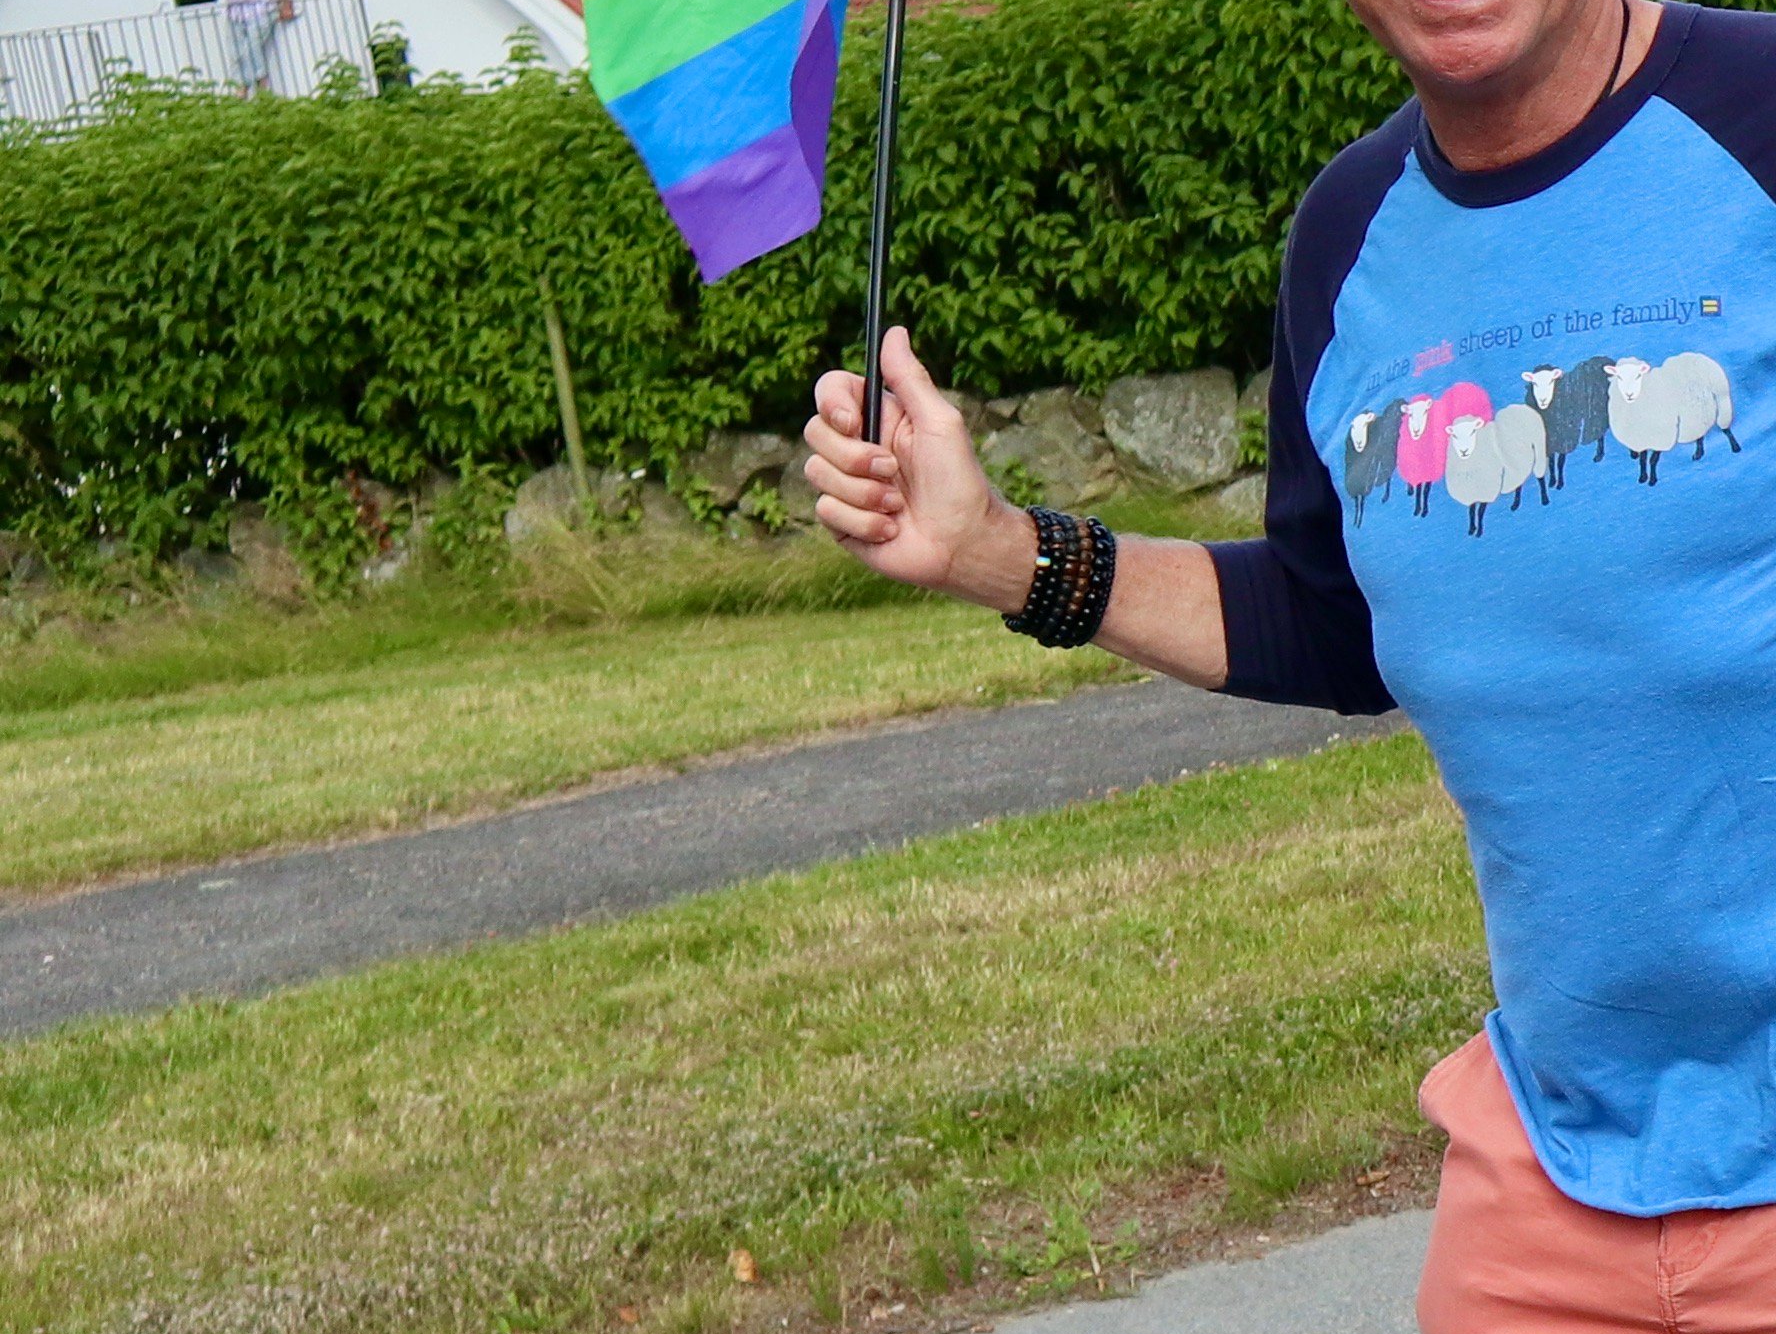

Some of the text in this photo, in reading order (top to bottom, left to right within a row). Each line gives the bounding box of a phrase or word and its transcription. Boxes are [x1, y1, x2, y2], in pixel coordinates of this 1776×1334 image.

[1459, 324, 1523, 357] sheep
[1531, 312, 1557, 341] of
[1563, 309, 1604, 334] the
[1612, 296, 1697, 326] family
